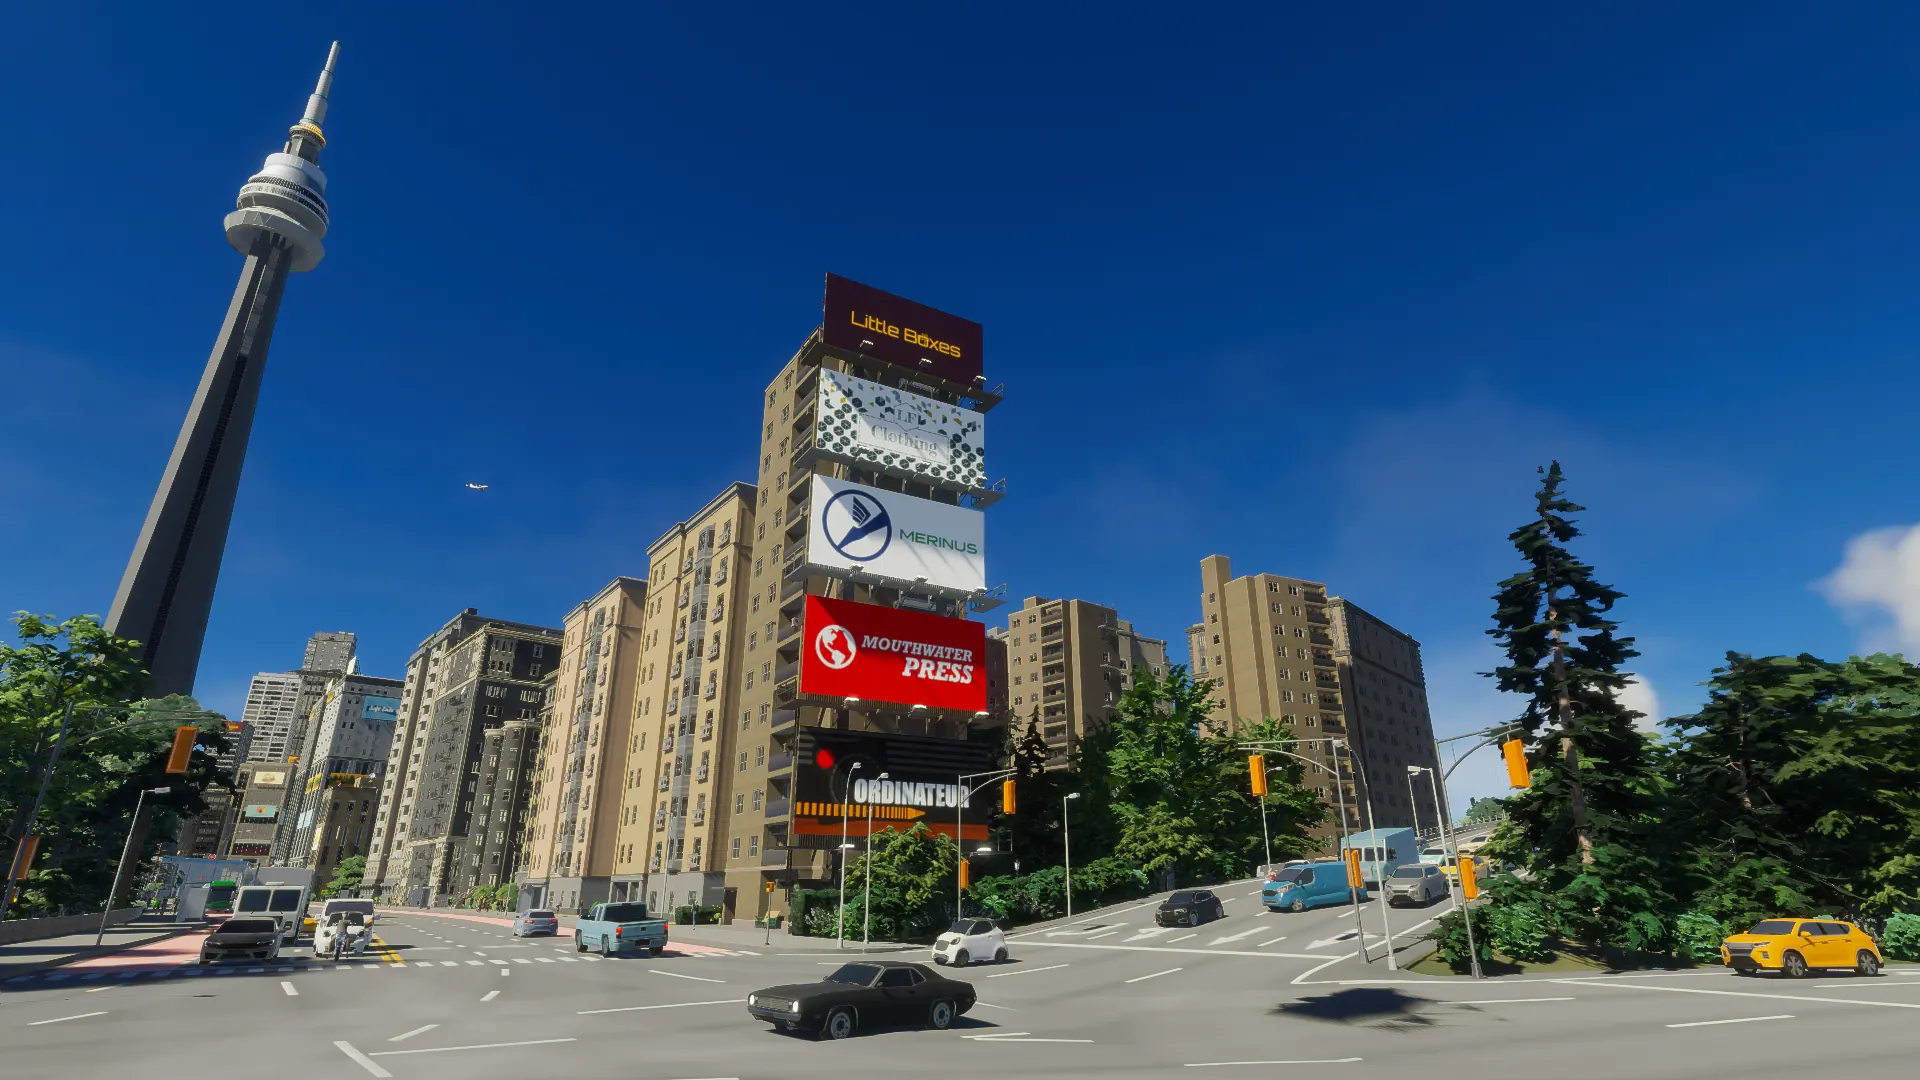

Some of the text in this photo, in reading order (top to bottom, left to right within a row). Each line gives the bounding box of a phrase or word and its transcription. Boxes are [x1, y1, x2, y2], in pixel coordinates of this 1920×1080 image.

[851, 311, 961, 358] Little Boxes
[871, 424, 938, 457] Clothing
[899, 529, 978, 555] MERINUS
[861, 635, 973, 662] MOUTHWATER
[902, 657, 974, 685] PRESS
[854, 778, 970, 809] ORDINATEUR
